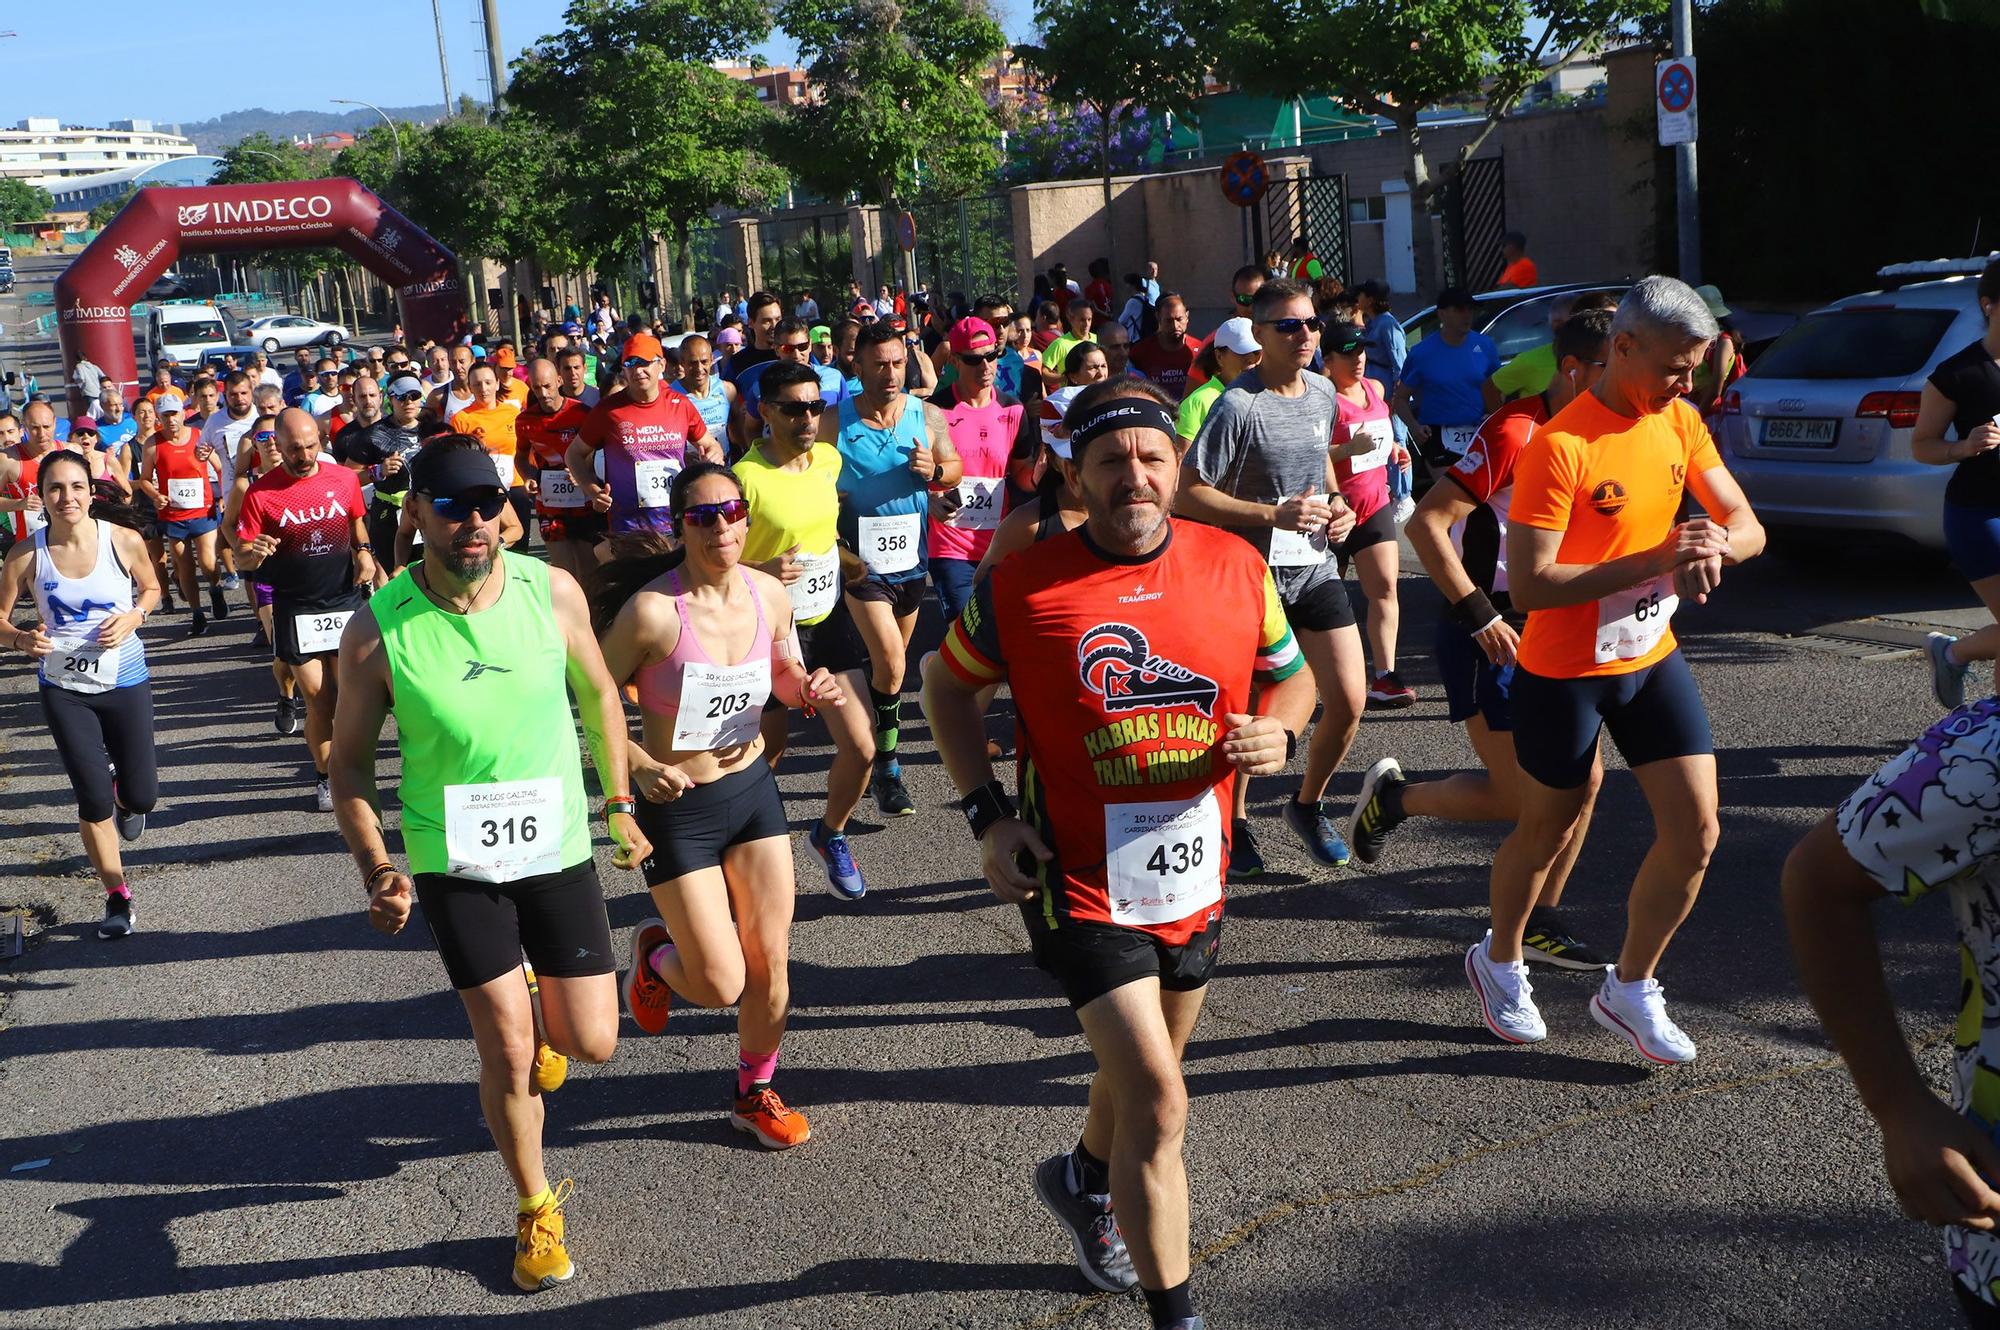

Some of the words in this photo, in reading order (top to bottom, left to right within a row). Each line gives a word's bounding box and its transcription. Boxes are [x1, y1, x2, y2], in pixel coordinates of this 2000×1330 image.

[213, 195, 332, 224] IMDECO
[180, 230, 212, 238] Instituto
[214, 226, 251, 236] Municipal
[265, 224, 300, 234] Deportes
[301, 222, 332, 230] Córdoba
[141, 258, 150, 267] DE
[415, 280, 458, 294] IMDECO
[76, 306, 126, 318] IMDECO
[1081, 406, 1141, 432] LURBEL
[622, 436, 635, 444] 36
[637, 431, 682, 444] MARATÓN
[636, 425, 665, 435] MEDIA
[1768, 422, 1802, 438] 8662
[1806, 423, 1833, 439] HKN
[178, 489, 196, 498] 423
[552, 483, 574, 494] 280
[966, 495, 992, 510] 324
[878, 535, 906, 552] 358
[807, 570, 833, 594] 332
[1118, 592, 1163, 604] TEAMERGY
[1635, 592, 1660, 622] 65
[313, 616, 343, 632] 326
[64, 656, 100, 674] 201
[1109, 674, 1133, 696] K
[706, 692, 750, 719] 203
[1083, 713, 1160, 758] KABRAS
[1166, 713, 1218, 747] LOKAS
[1093, 754, 1143, 786] TRAIL
[490, 793, 505, 801] LOS
[1134, 815, 1146, 823] 10
[1148, 815, 1155, 823] K
[1157, 814, 1175, 823] LOS
[481, 816, 537, 848] 316
[1146, 836, 1203, 876] 438
